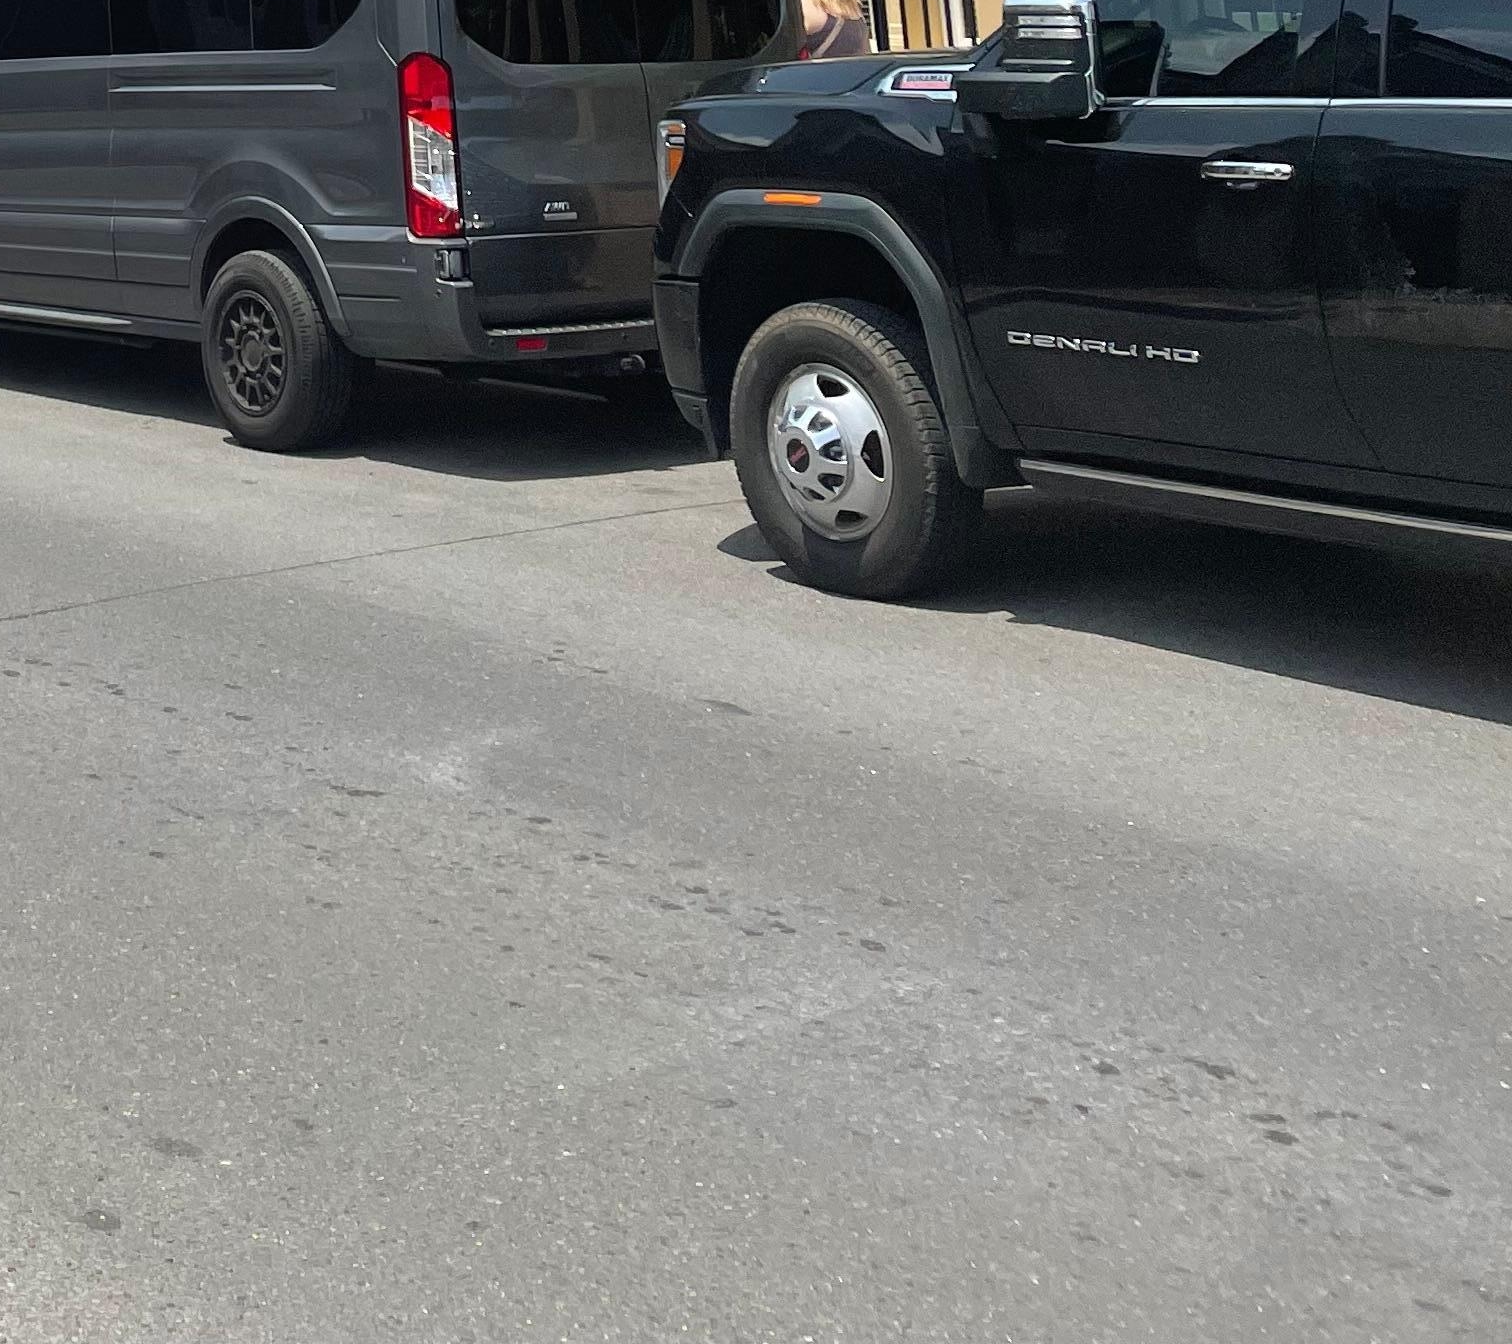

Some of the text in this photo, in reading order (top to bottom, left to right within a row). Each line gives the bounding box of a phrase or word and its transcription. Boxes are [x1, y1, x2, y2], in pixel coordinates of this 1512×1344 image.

[907, 74, 949, 82] DURAMAX
[1006, 330, 1201, 363] DENALI HD
